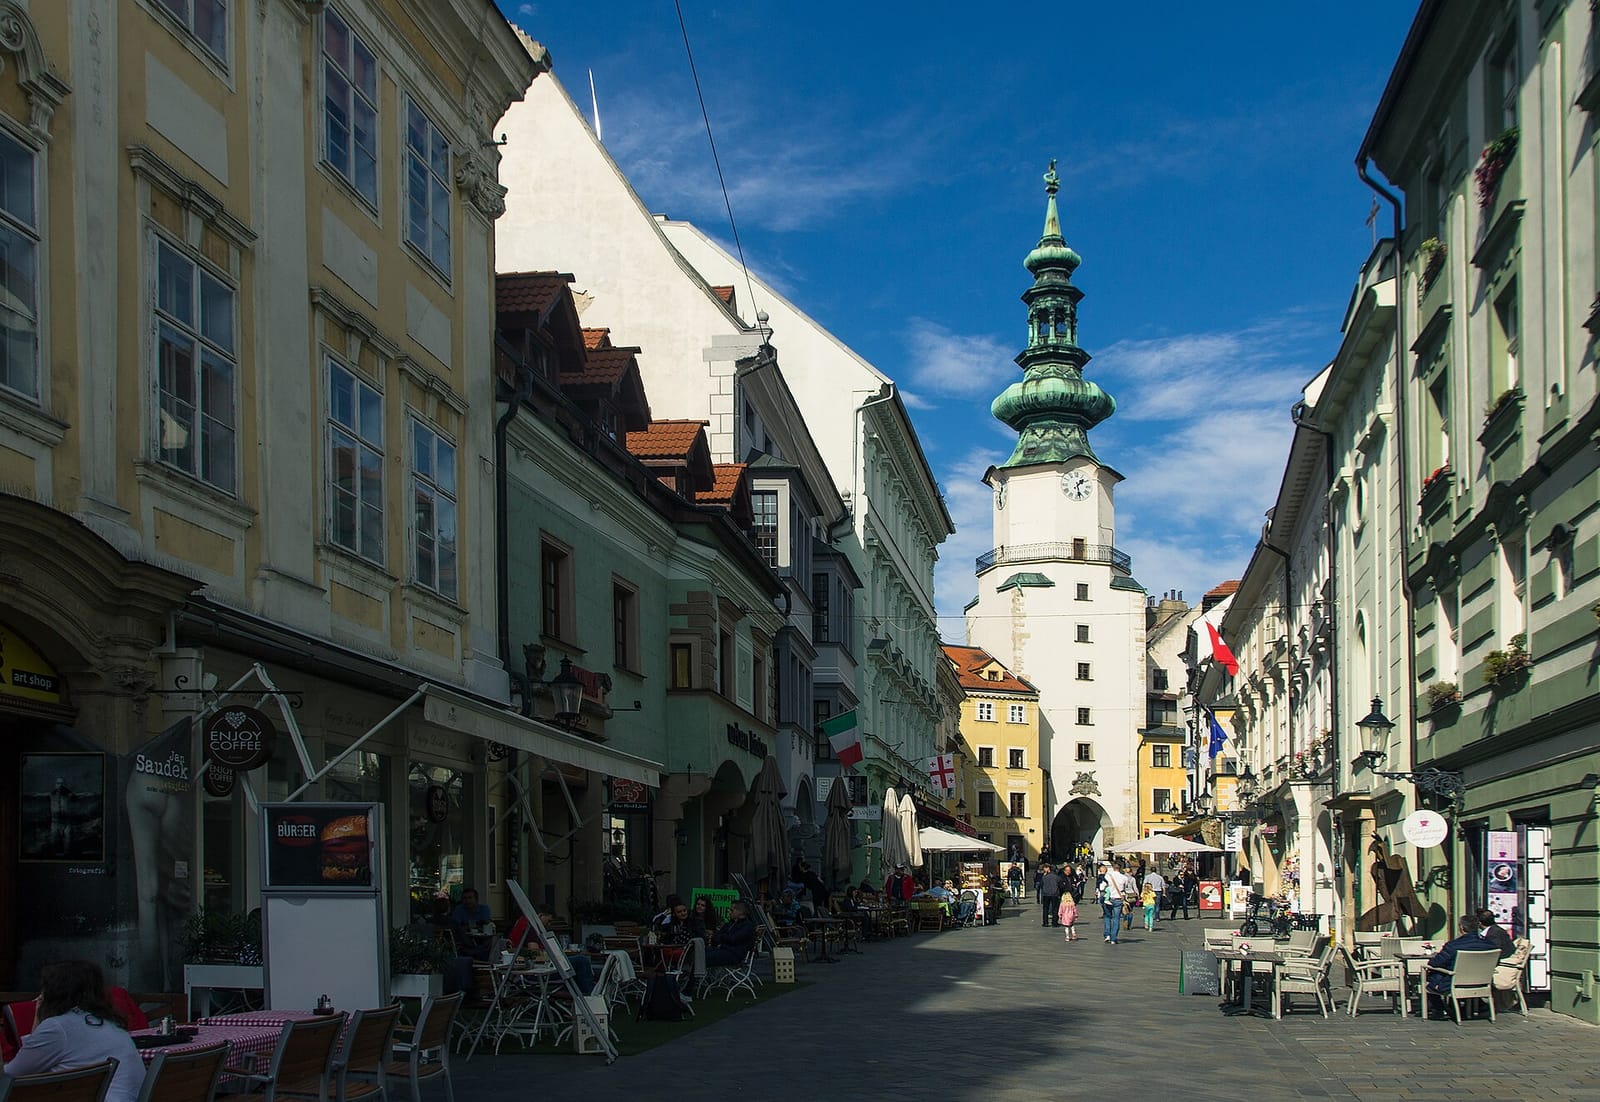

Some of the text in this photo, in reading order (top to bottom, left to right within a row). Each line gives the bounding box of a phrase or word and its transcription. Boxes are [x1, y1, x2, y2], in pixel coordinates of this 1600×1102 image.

[14, 673, 52, 690] art shop
[210, 731, 262, 741] ENJOY
[210, 741, 262, 751] COFFEE
[169, 751, 185, 764] Jan
[136, 754, 189, 780] Saudek
[209, 764, 234, 776] ENJOY
[209, 773, 233, 783] COFFEE
[277, 823, 316, 838] BURGER
